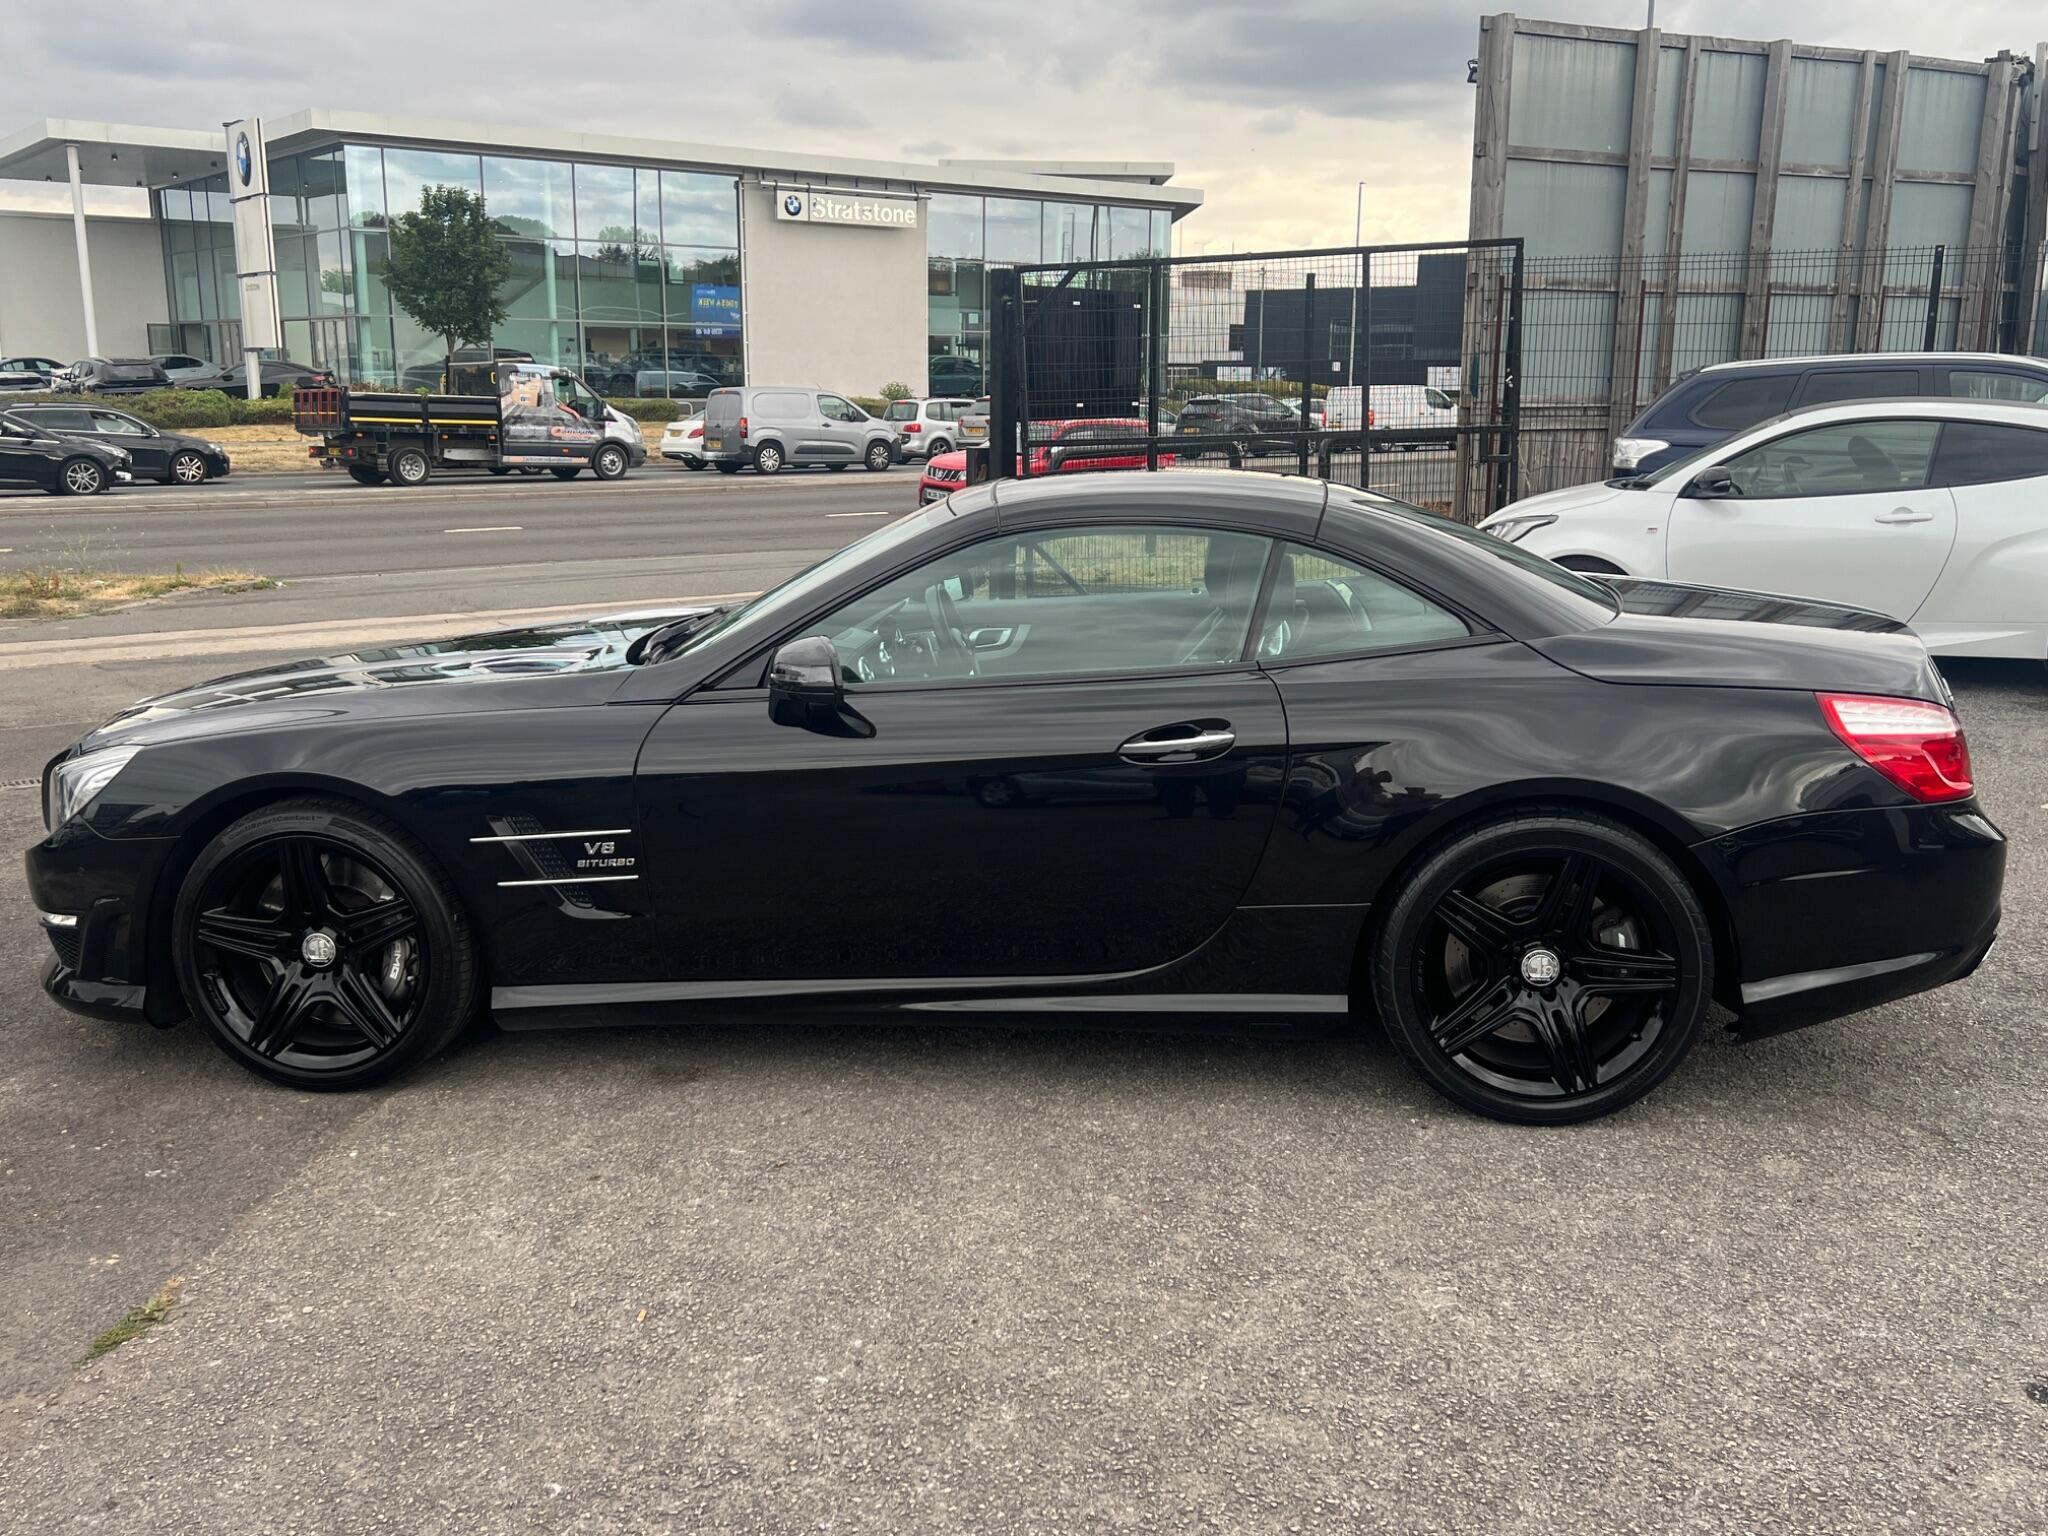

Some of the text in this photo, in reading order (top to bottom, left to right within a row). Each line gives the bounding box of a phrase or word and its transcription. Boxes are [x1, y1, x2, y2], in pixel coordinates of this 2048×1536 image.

[813, 197, 916, 224] Stratstone
[584, 842, 615, 855] V8
[577, 858, 635, 868] BITURBO
